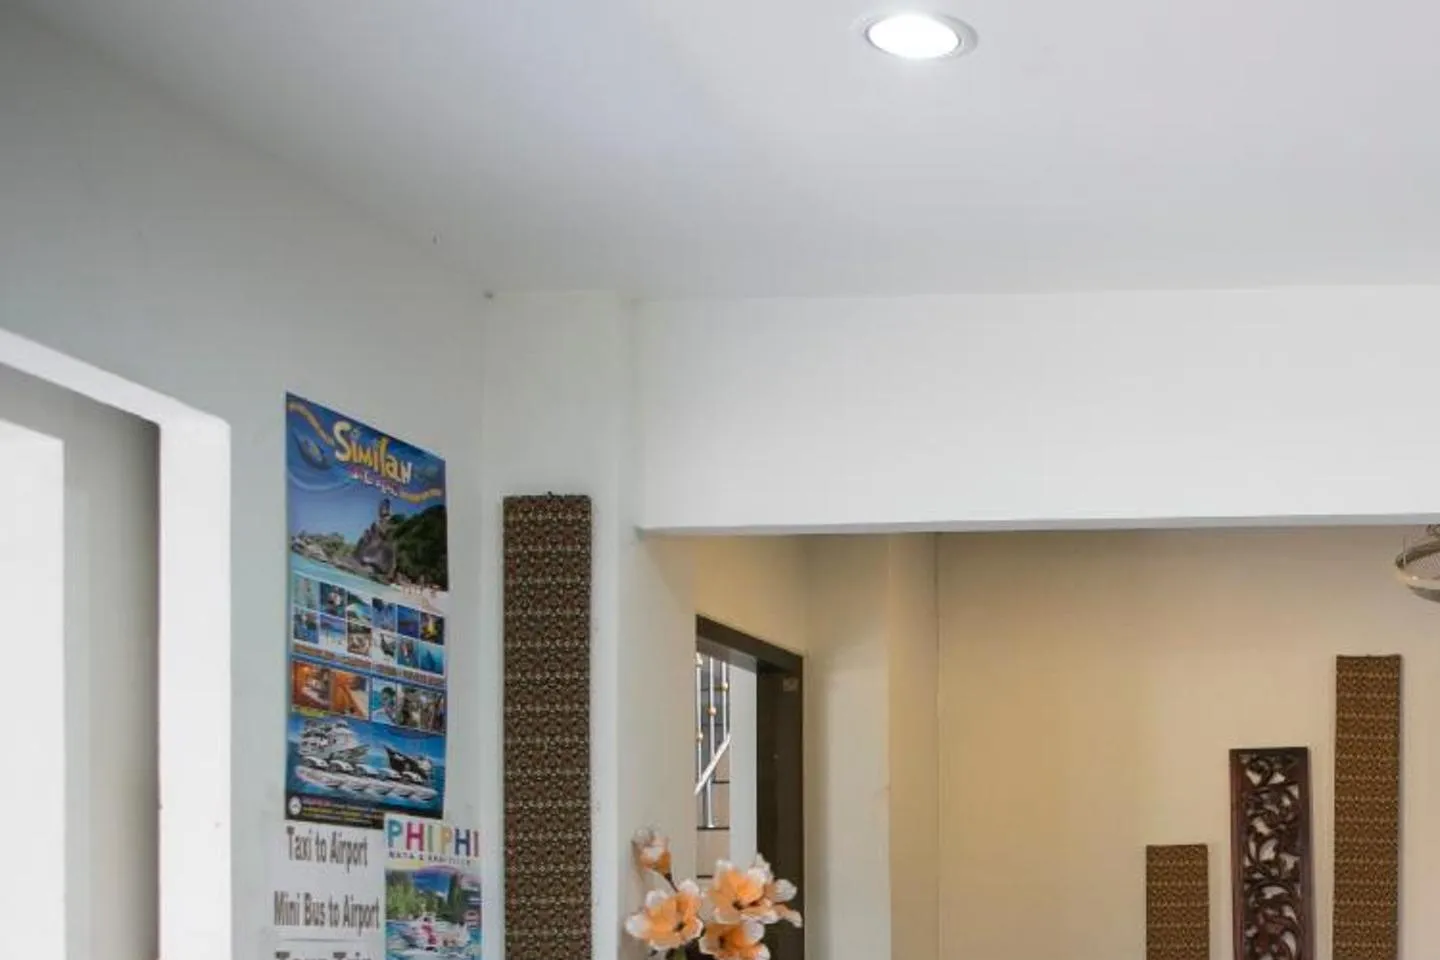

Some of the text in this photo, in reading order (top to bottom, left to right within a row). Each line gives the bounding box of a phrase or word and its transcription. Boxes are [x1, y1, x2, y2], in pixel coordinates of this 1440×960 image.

[286, 826, 313, 860] Taxi
[315, 832, 327, 864] to
[329, 831, 369, 873] Airport
[273, 891, 380, 936] Mini Bus to Airport
